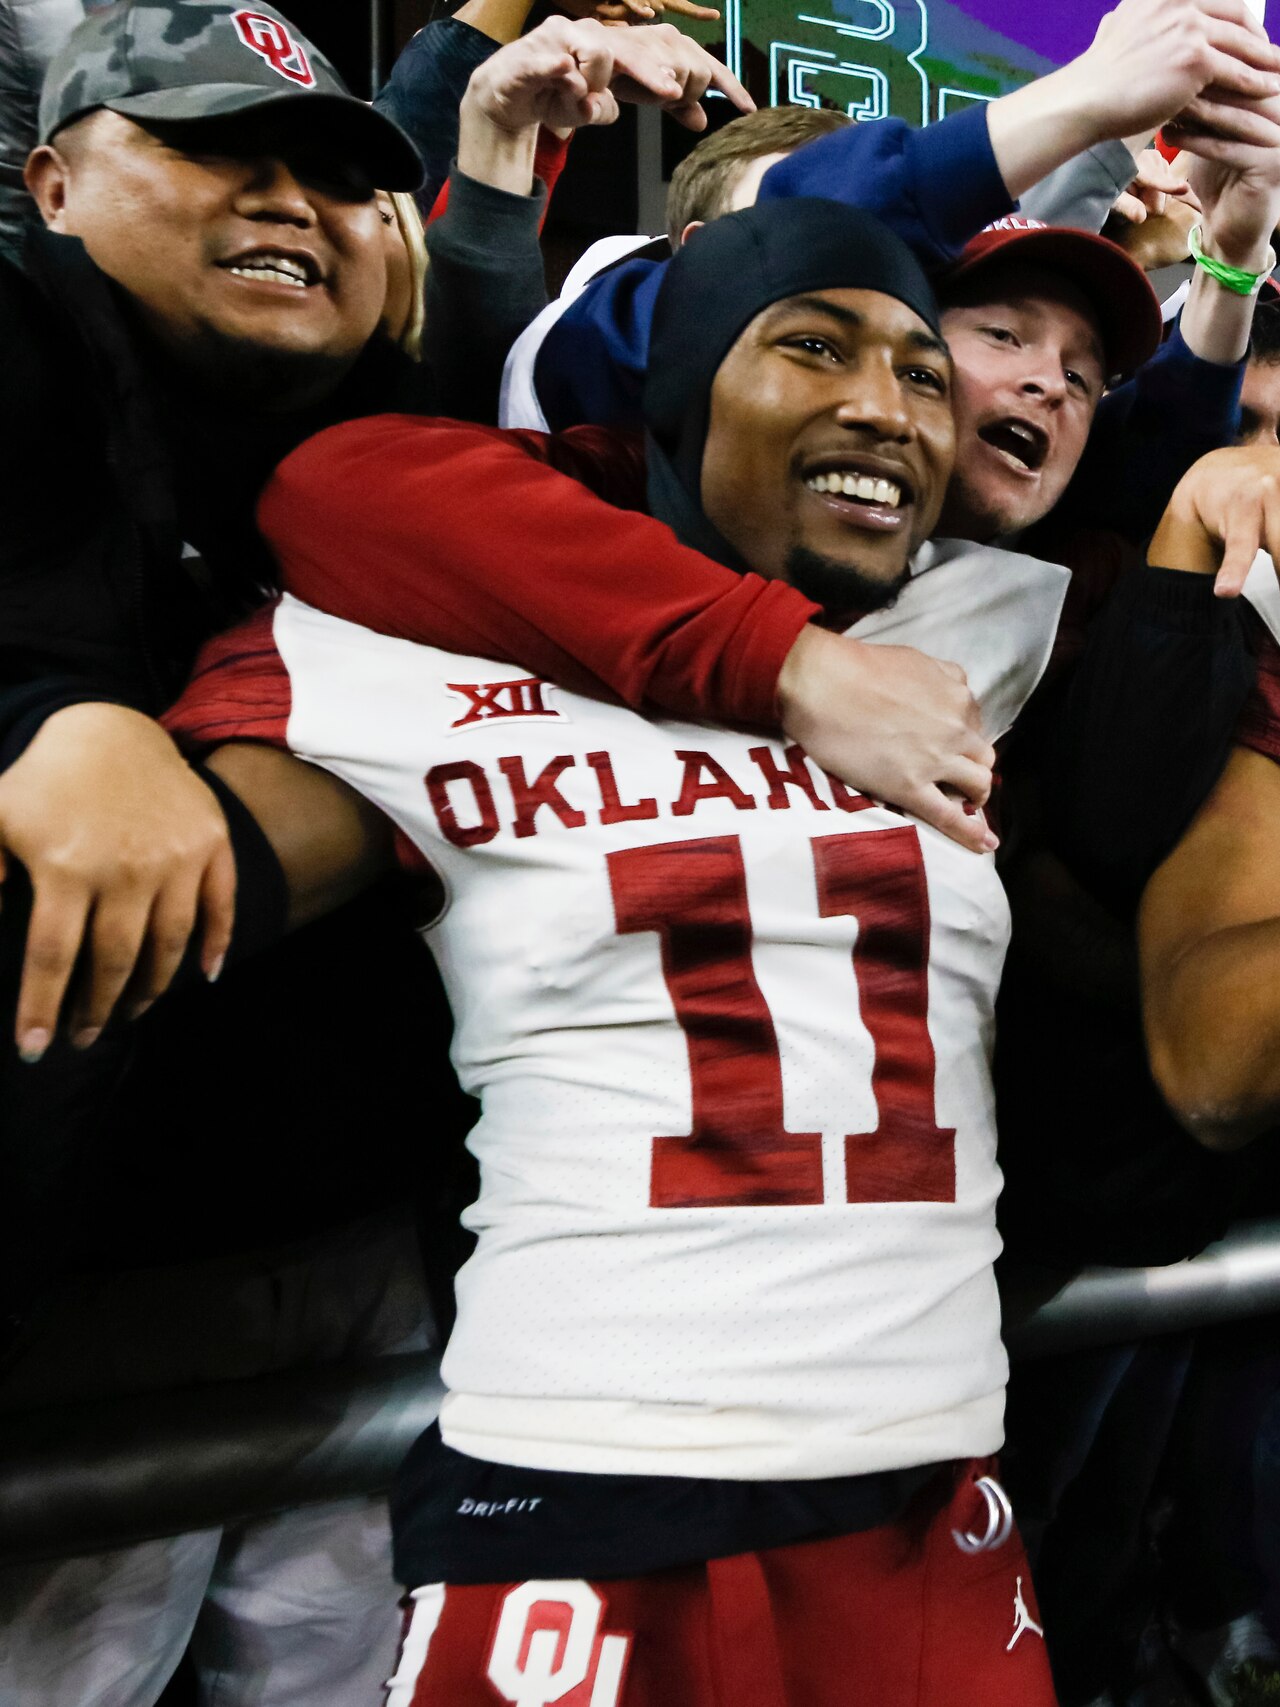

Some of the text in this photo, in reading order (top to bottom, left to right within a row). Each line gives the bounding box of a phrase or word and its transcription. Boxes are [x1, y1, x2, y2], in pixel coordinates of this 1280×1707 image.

[230, 9, 317, 90] OU
[606, 824, 957, 1208] 11
[456, 1497, 543, 1516] DRI-FIT
